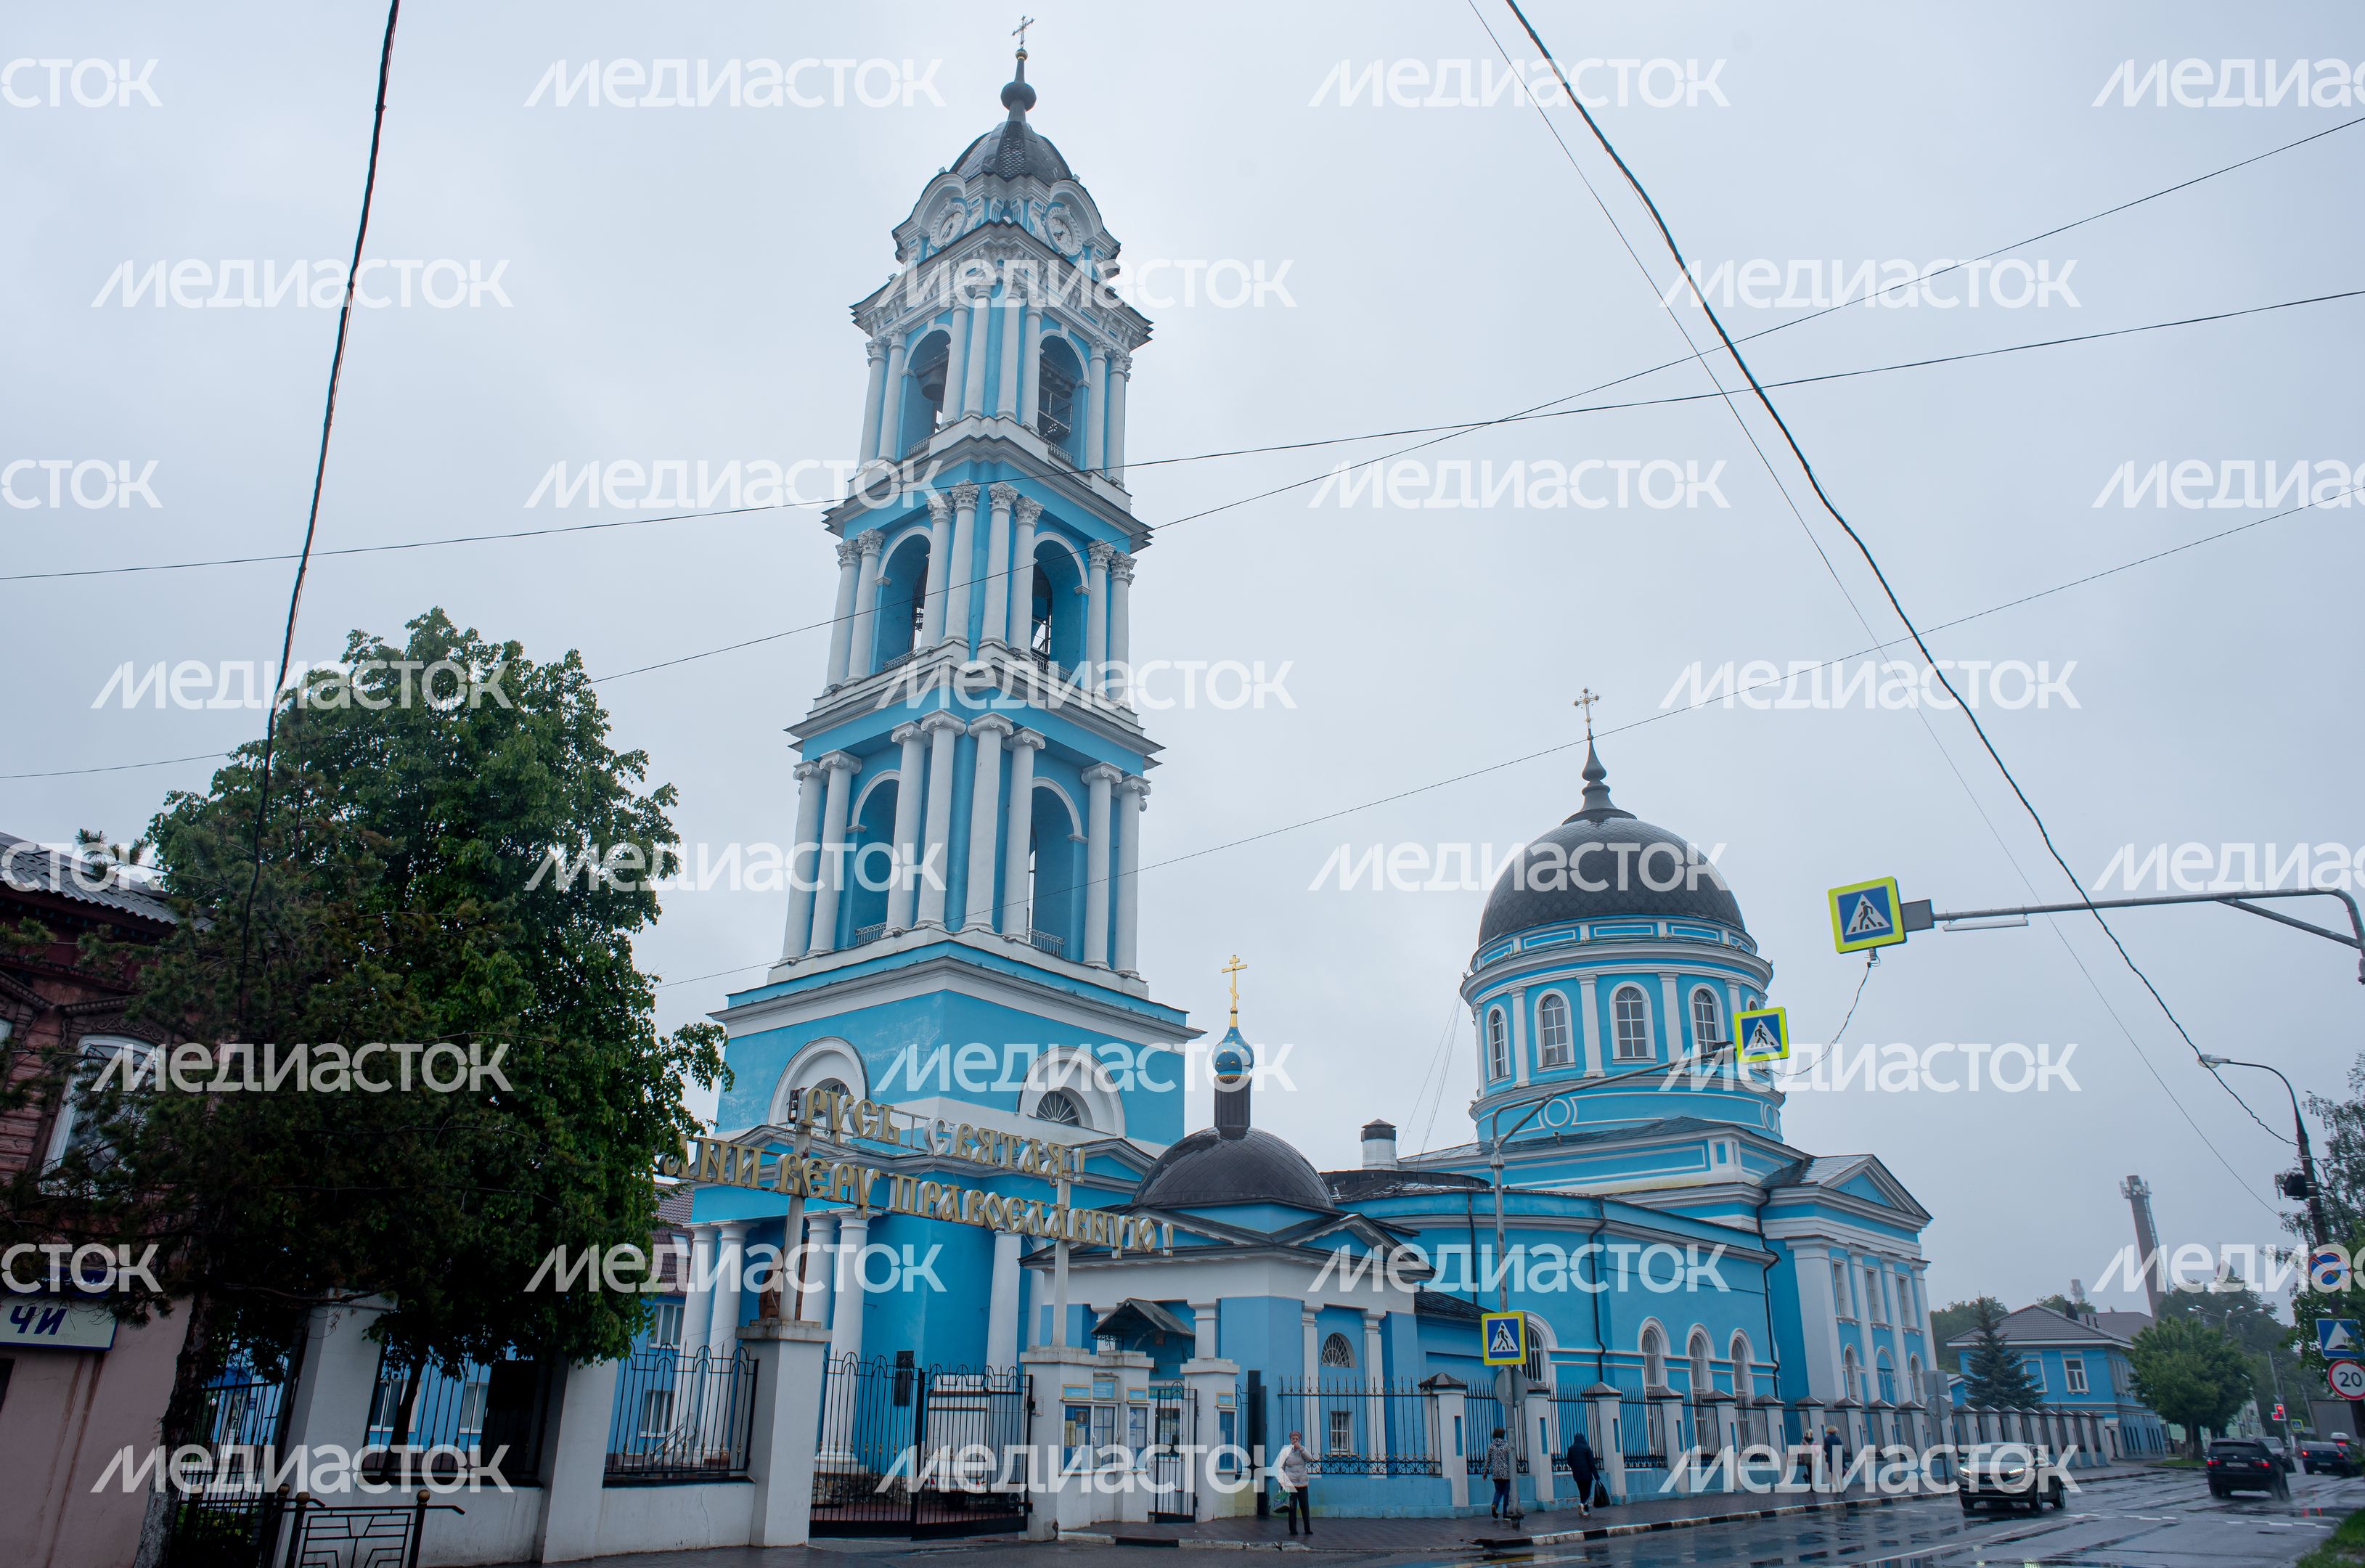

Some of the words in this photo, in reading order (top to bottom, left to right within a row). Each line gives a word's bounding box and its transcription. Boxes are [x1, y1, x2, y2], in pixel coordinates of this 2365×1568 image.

[798, 1088, 901, 1145] РУСЬ
[774, 1153, 881, 1220] ВЕРУ
[2338, 1371, 2363, 1387] 20
